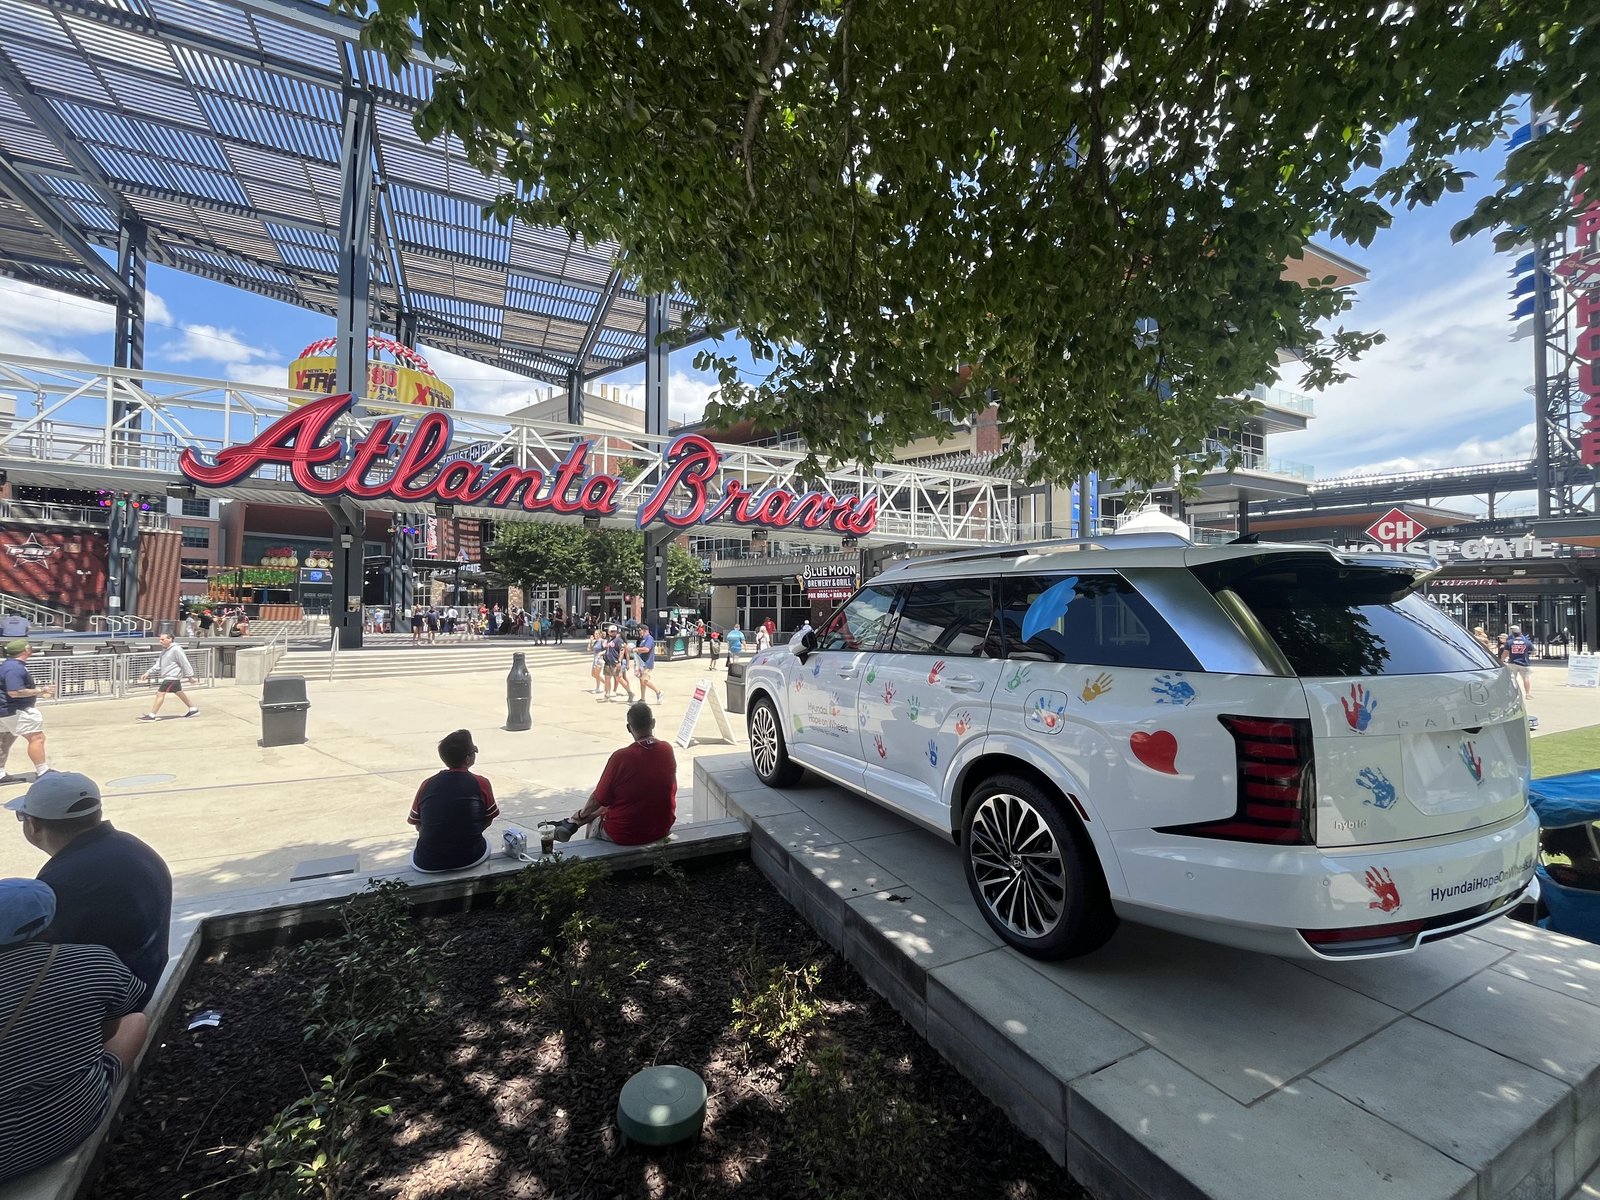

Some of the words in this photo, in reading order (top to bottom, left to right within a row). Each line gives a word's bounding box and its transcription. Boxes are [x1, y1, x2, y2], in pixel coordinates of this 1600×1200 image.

[368, 367, 398, 387] 80
[178, 391, 624, 518] Atlanta
[635, 432, 879, 538] Braves
[1378, 521, 1413, 540] CH
[1461, 538, 1554, 559] GATE
[305, 557, 333, 569] RO
[803, 564, 827, 579] BLUE
[829, 565, 856, 576] MOON
[807, 579, 831, 587] BREWERY
[837, 578, 851, 587] GRILL
[1426, 593, 1464, 604] ARK
[1511, 644, 1526, 654] 27
[1334, 819, 1368, 831] hybrid
